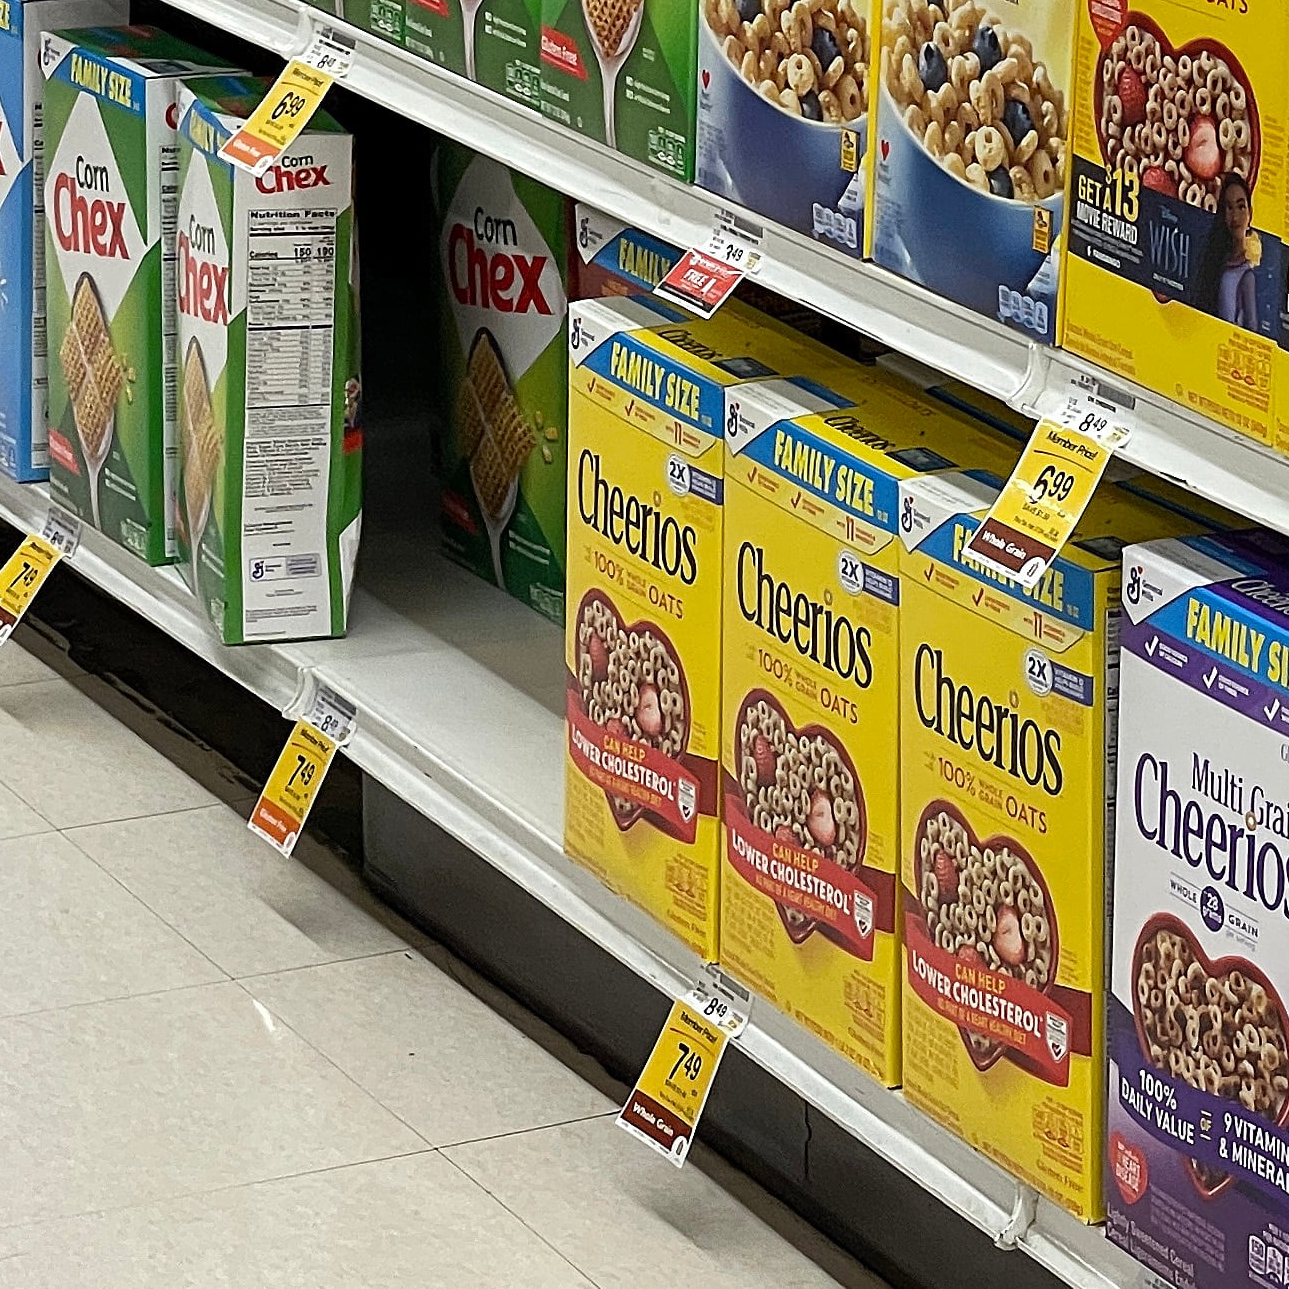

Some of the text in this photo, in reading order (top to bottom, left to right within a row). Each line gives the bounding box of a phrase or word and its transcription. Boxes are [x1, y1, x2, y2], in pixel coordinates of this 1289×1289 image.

[71, 54, 132, 108] FAMILY SIZE
[271, 91, 306, 120] 699
[76, 155, 110, 192] Corn
[281, 154, 313, 167] Corn
[54, 173, 131, 261] Chex
[250, 210, 334, 219] Nutrition Facts
[474, 206, 518, 246] Corn
[448, 223, 552, 317] Chex
[610, 341, 701, 421] FAMILY SIZE
[1078, 413, 1108, 431] 849
[669, 459, 687, 483] 2X
[773, 434, 875, 515] FAMILY SIZE
[578, 448, 698, 586] Cheerios
[840, 561, 861, 586] 2X
[737, 540, 874, 690] Cheerios
[1185, 599, 1264, 673] FAMILY
[914, 643, 1063, 797] Cheerios
[1193, 752, 1243, 812] Multi
[732, 829, 852, 917] LOWER CHOLESTEROL
[772, 842, 819, 872] CAN HELP
[912, 948, 1041, 1034] LOWER CHOLESTEROL
[669, 1042, 702, 1080] 749
